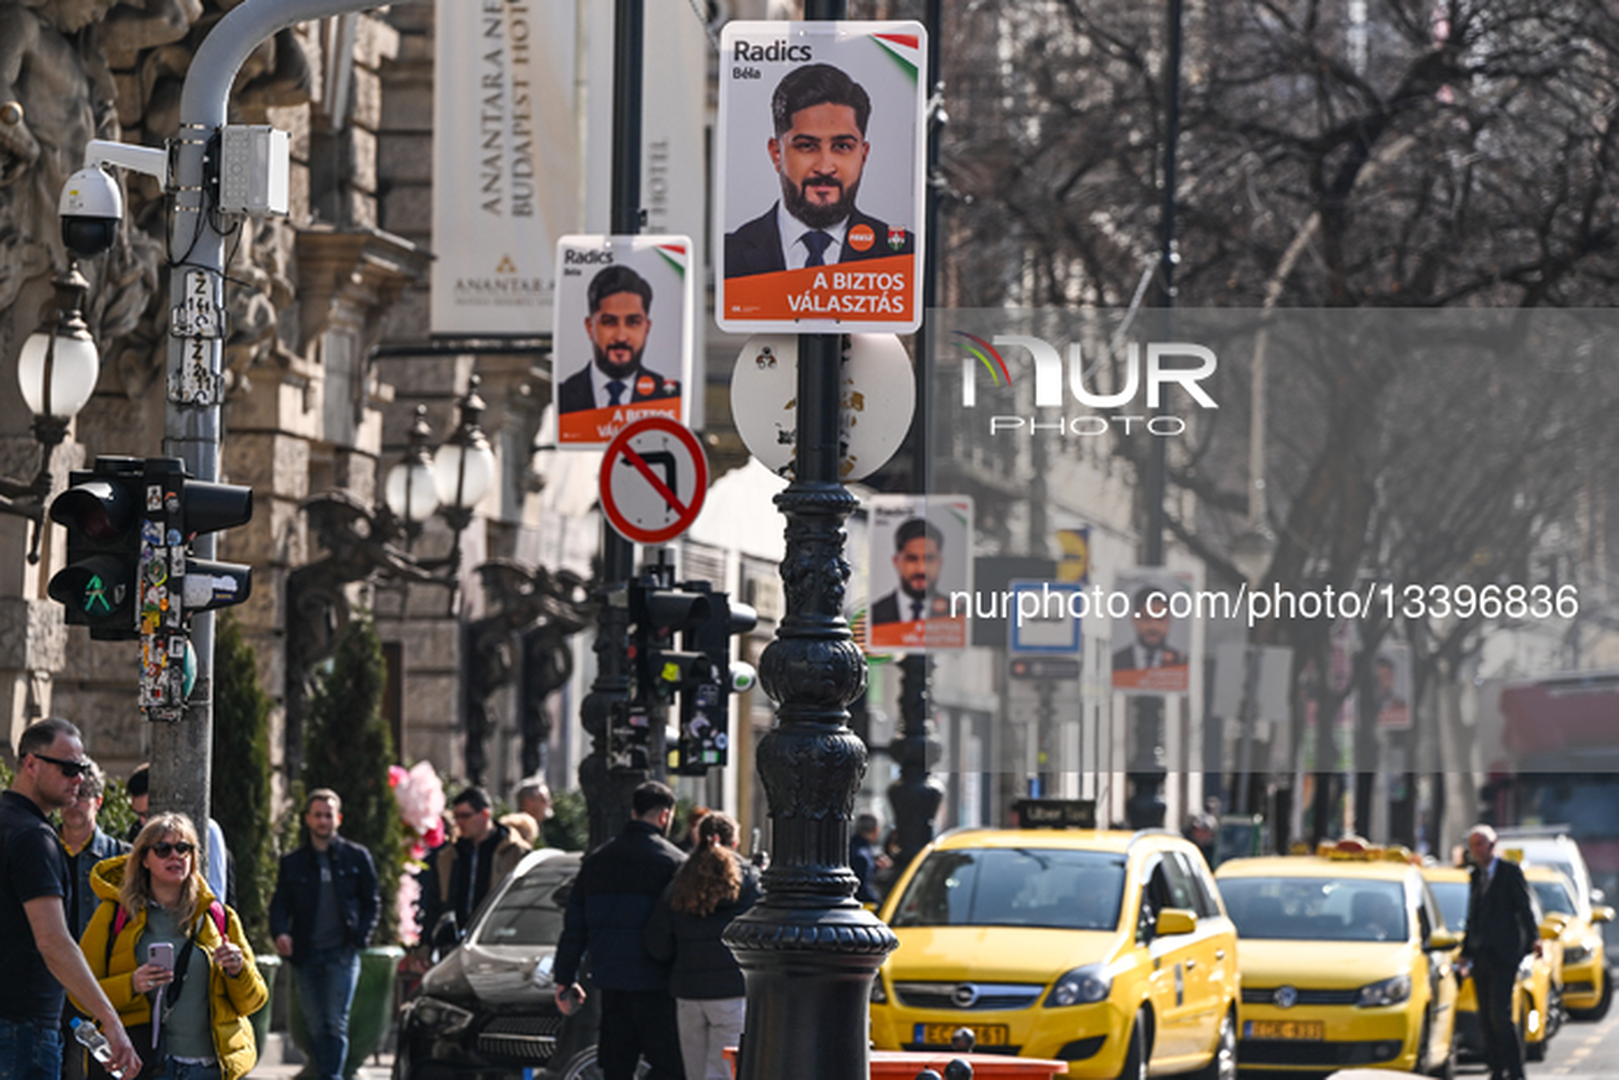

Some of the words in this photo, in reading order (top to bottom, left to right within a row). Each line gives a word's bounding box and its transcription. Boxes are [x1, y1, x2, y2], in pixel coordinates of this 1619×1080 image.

[733, 40, 812, 62] Radics
[732, 67, 761, 79] Béla
[481, 48, 504, 215] ANANTARA
[512, 75, 534, 217] BUDAPEST
[565, 249, 614, 264] Radics
[813, 272, 829, 290] A
[833, 272, 905, 291] BIZTOS
[787, 292, 904, 314] VÁLASZTÁS
[613, 409, 624, 422] A
